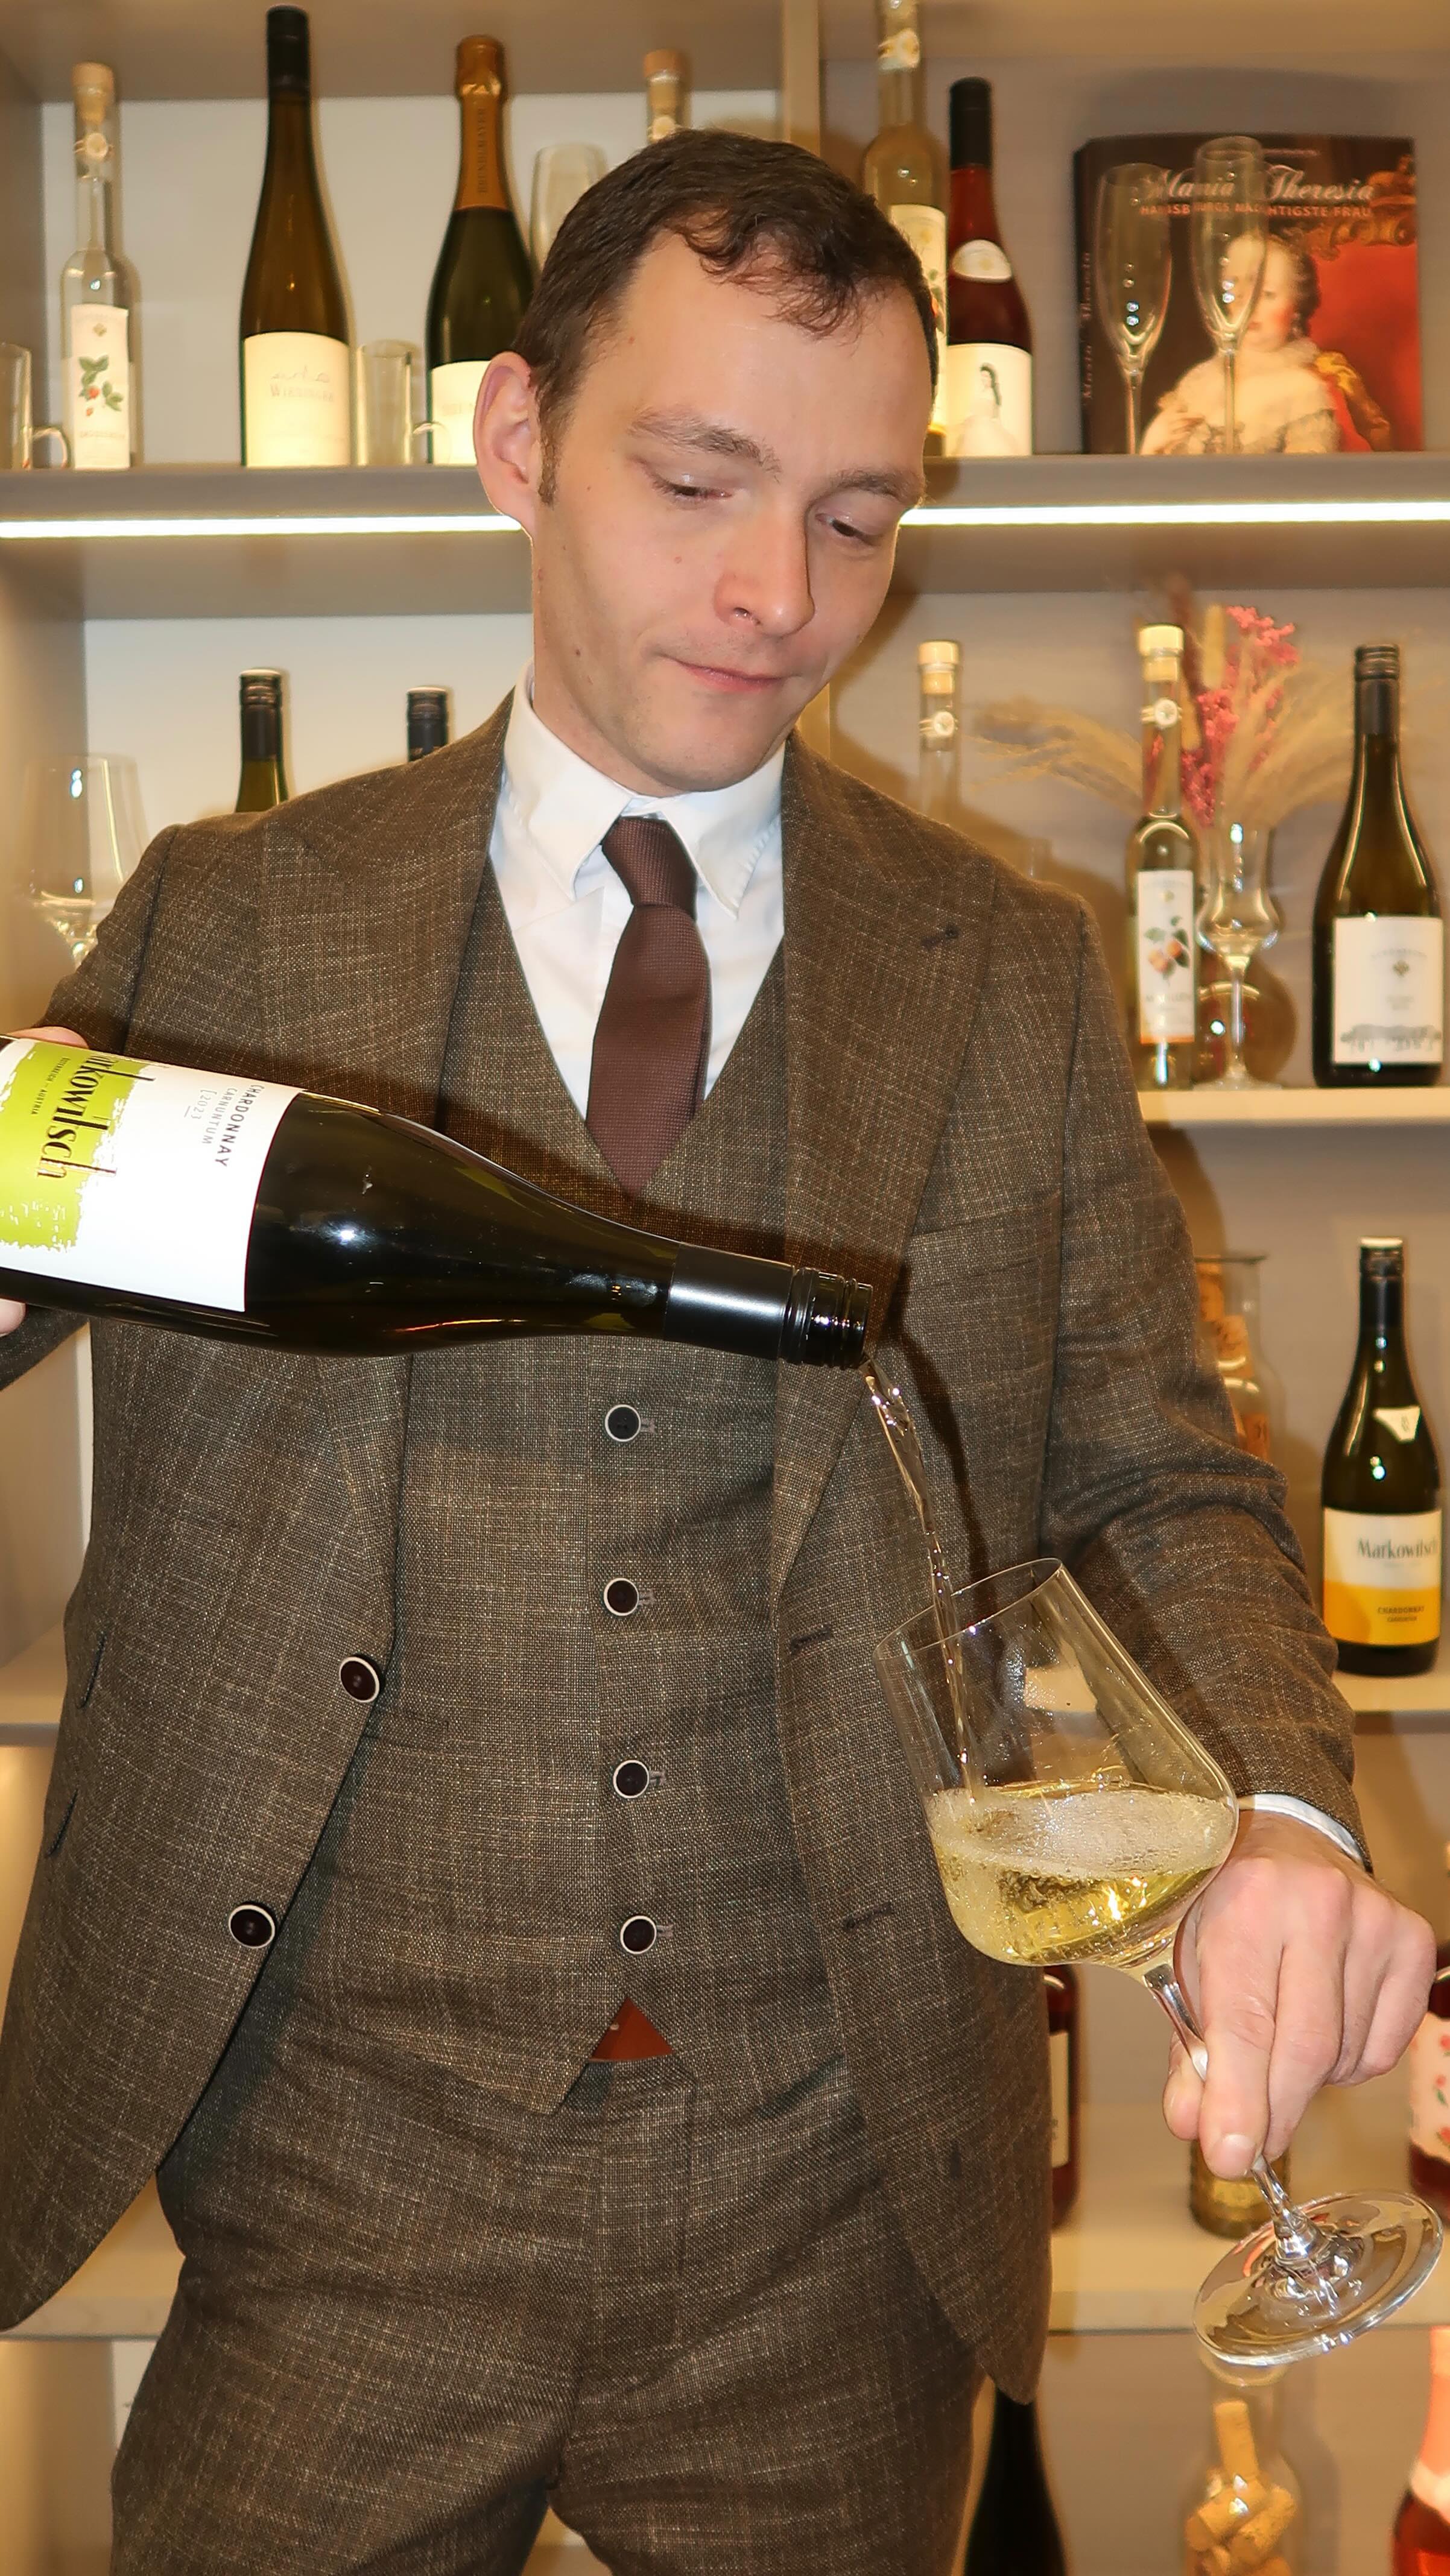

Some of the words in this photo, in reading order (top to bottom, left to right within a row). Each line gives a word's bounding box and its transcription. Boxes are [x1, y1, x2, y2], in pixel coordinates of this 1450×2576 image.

[1267, 164, 1375, 200] Theresia
[1334, 205, 1372, 218] FRAU
[201, 1088, 238, 1144] CARNUNTUM
[215, 1084, 265, 1167] CHARDONNAY
